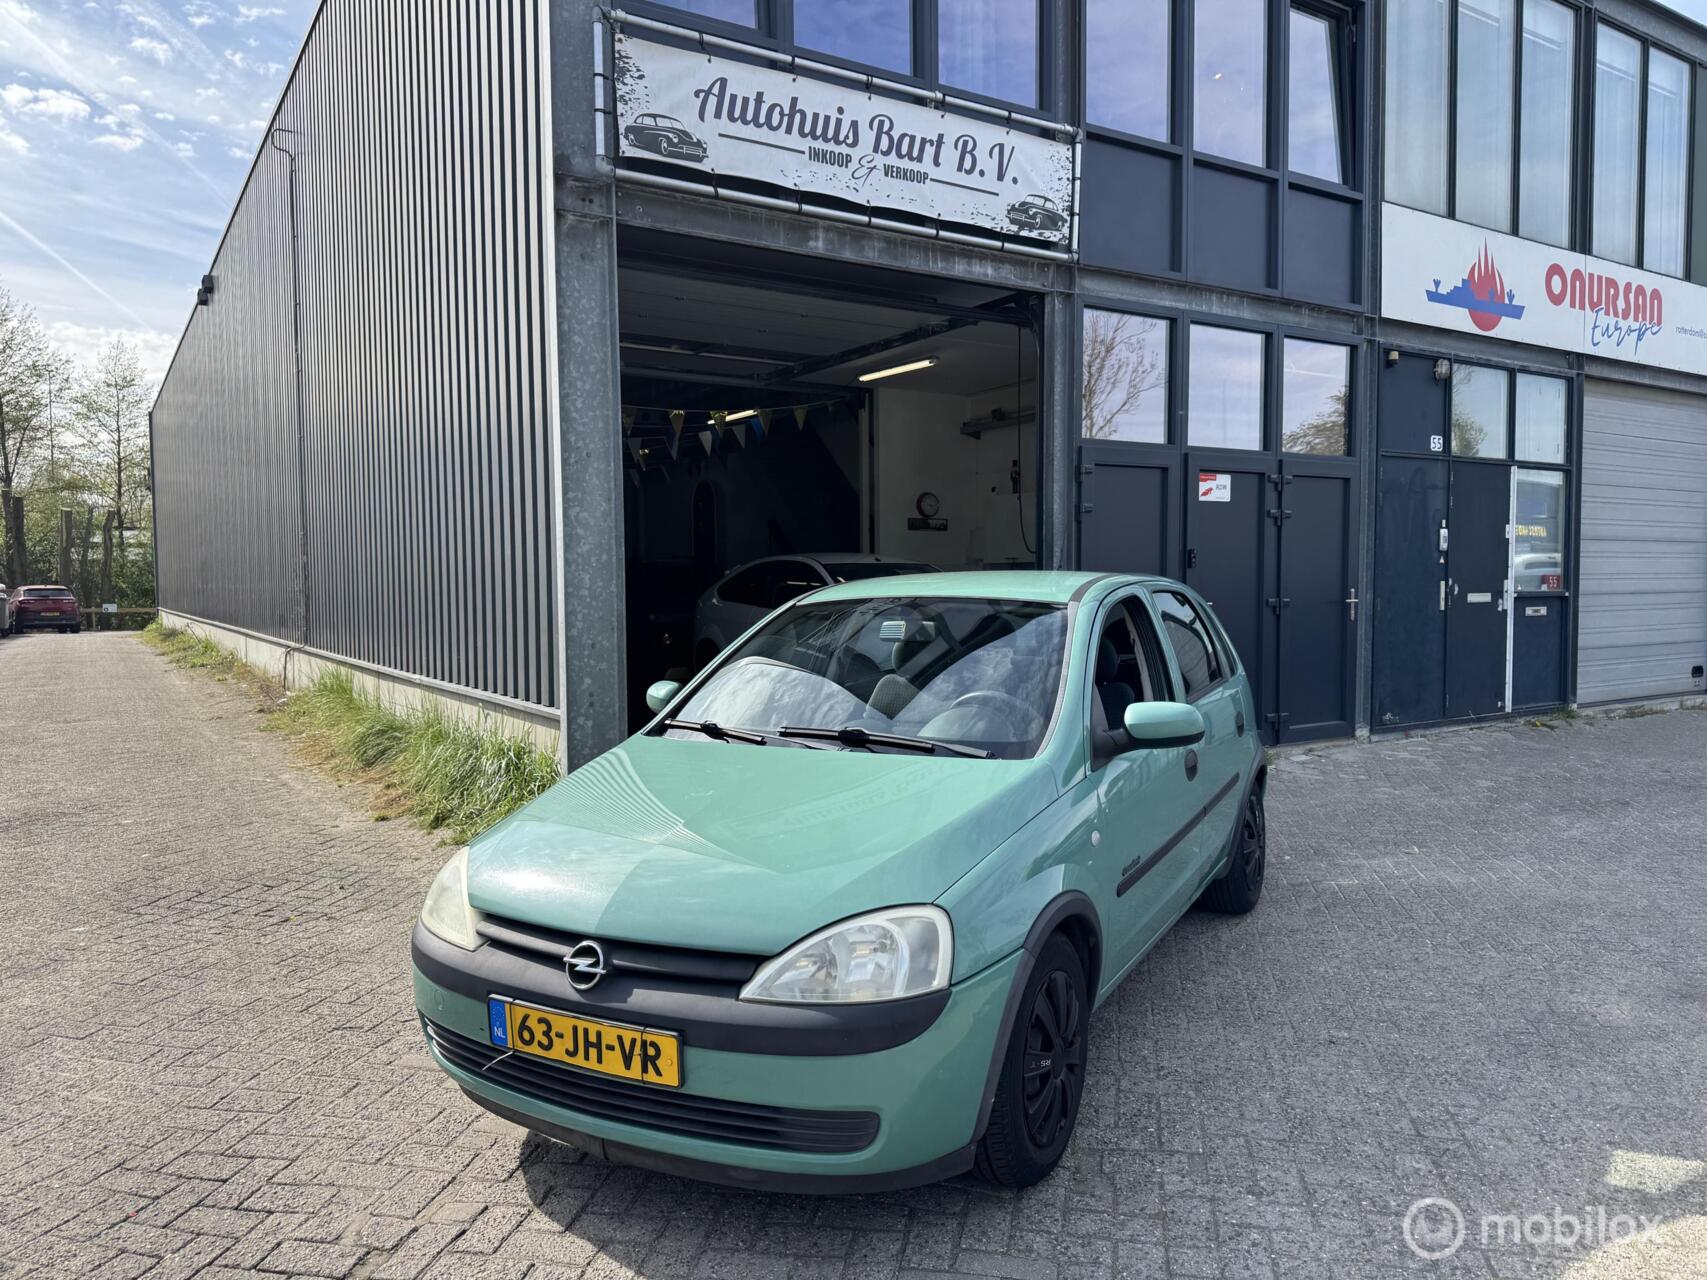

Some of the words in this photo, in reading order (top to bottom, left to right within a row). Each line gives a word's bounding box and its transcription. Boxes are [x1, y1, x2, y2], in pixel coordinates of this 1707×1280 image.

[694, 76, 862, 149] Autohuis
[868, 113, 947, 168] Bart
[954, 134, 1020, 185] B.V.
[808, 145, 853, 169] INKOOP
[851, 154, 881, 187] &
[883, 163, 930, 185] VERKOOP
[1545, 262, 1663, 328] ONURSAN
[1591, 306, 1663, 356] Europe
[1431, 437, 1442, 450] 55
[1549, 576, 1558, 588] 55
[493, 1026, 506, 1040] NL
[517, 1013, 663, 1078] 63-JH-VR
